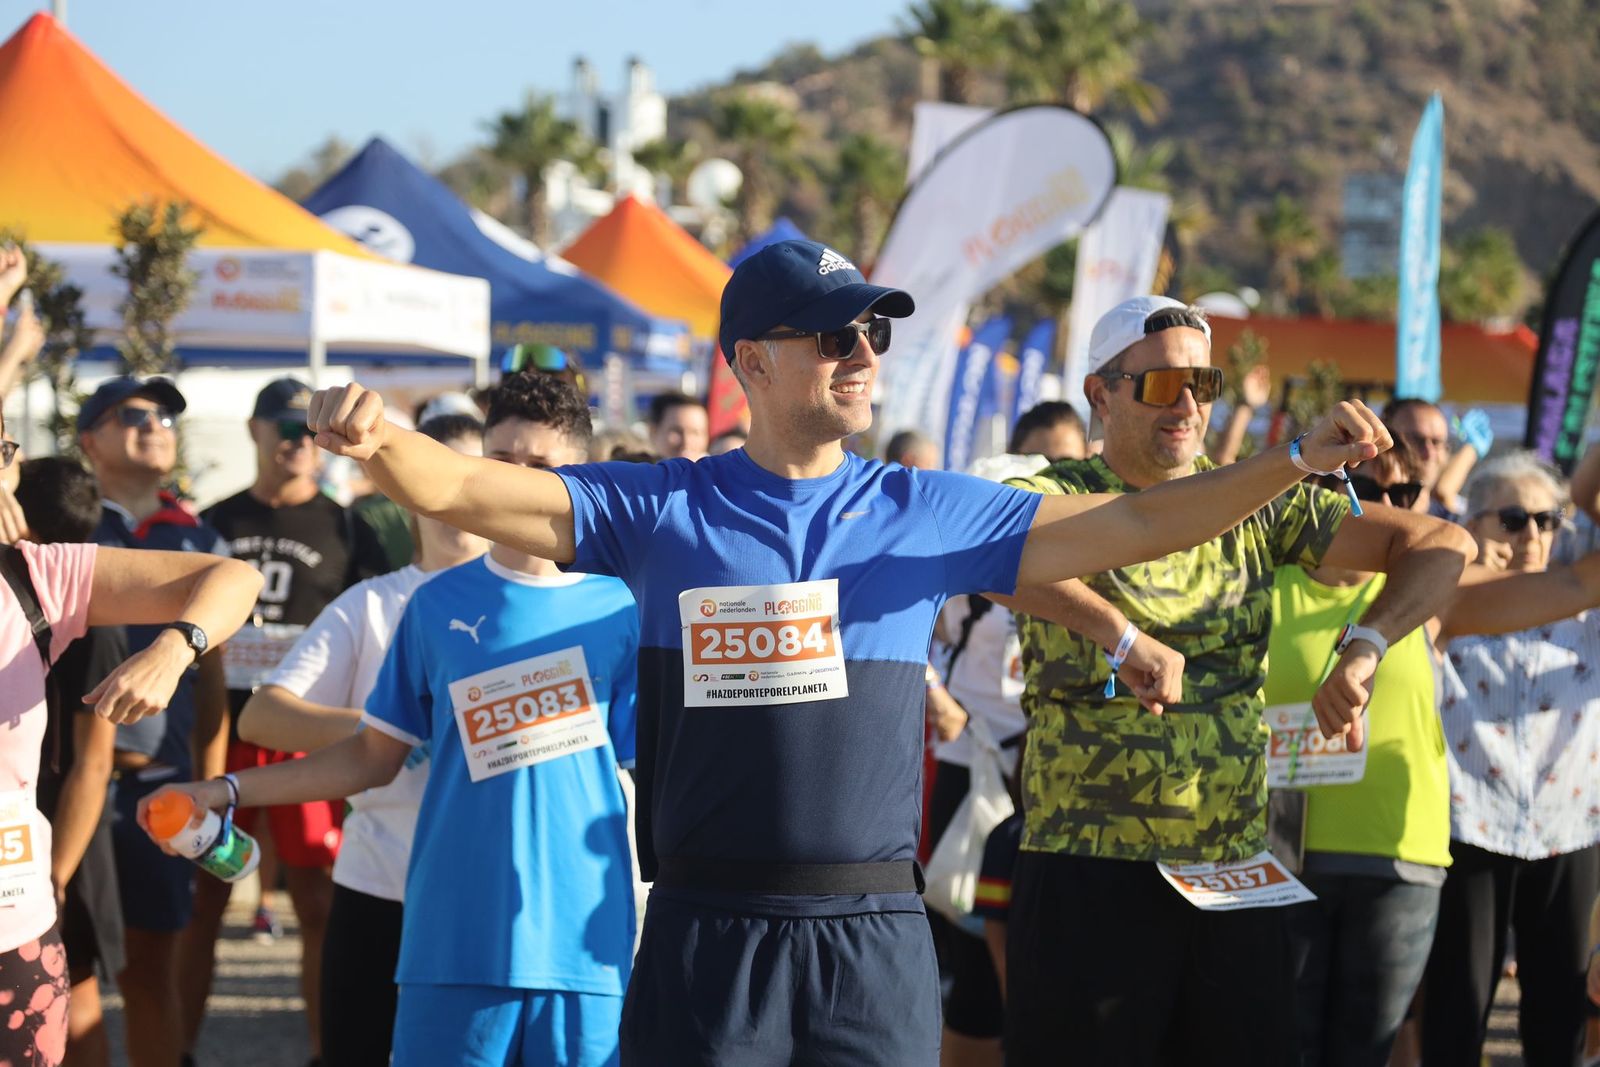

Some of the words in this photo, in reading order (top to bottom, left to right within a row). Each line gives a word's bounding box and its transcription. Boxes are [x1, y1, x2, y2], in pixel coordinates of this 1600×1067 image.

[819, 261, 856, 275] adidas
[700, 622, 827, 659] 25084
[706, 682, 828, 699] #HAZDEPORTEPORELPLANETA
[472, 684, 582, 739] 25083
[1184, 866, 1268, 892] 25137
